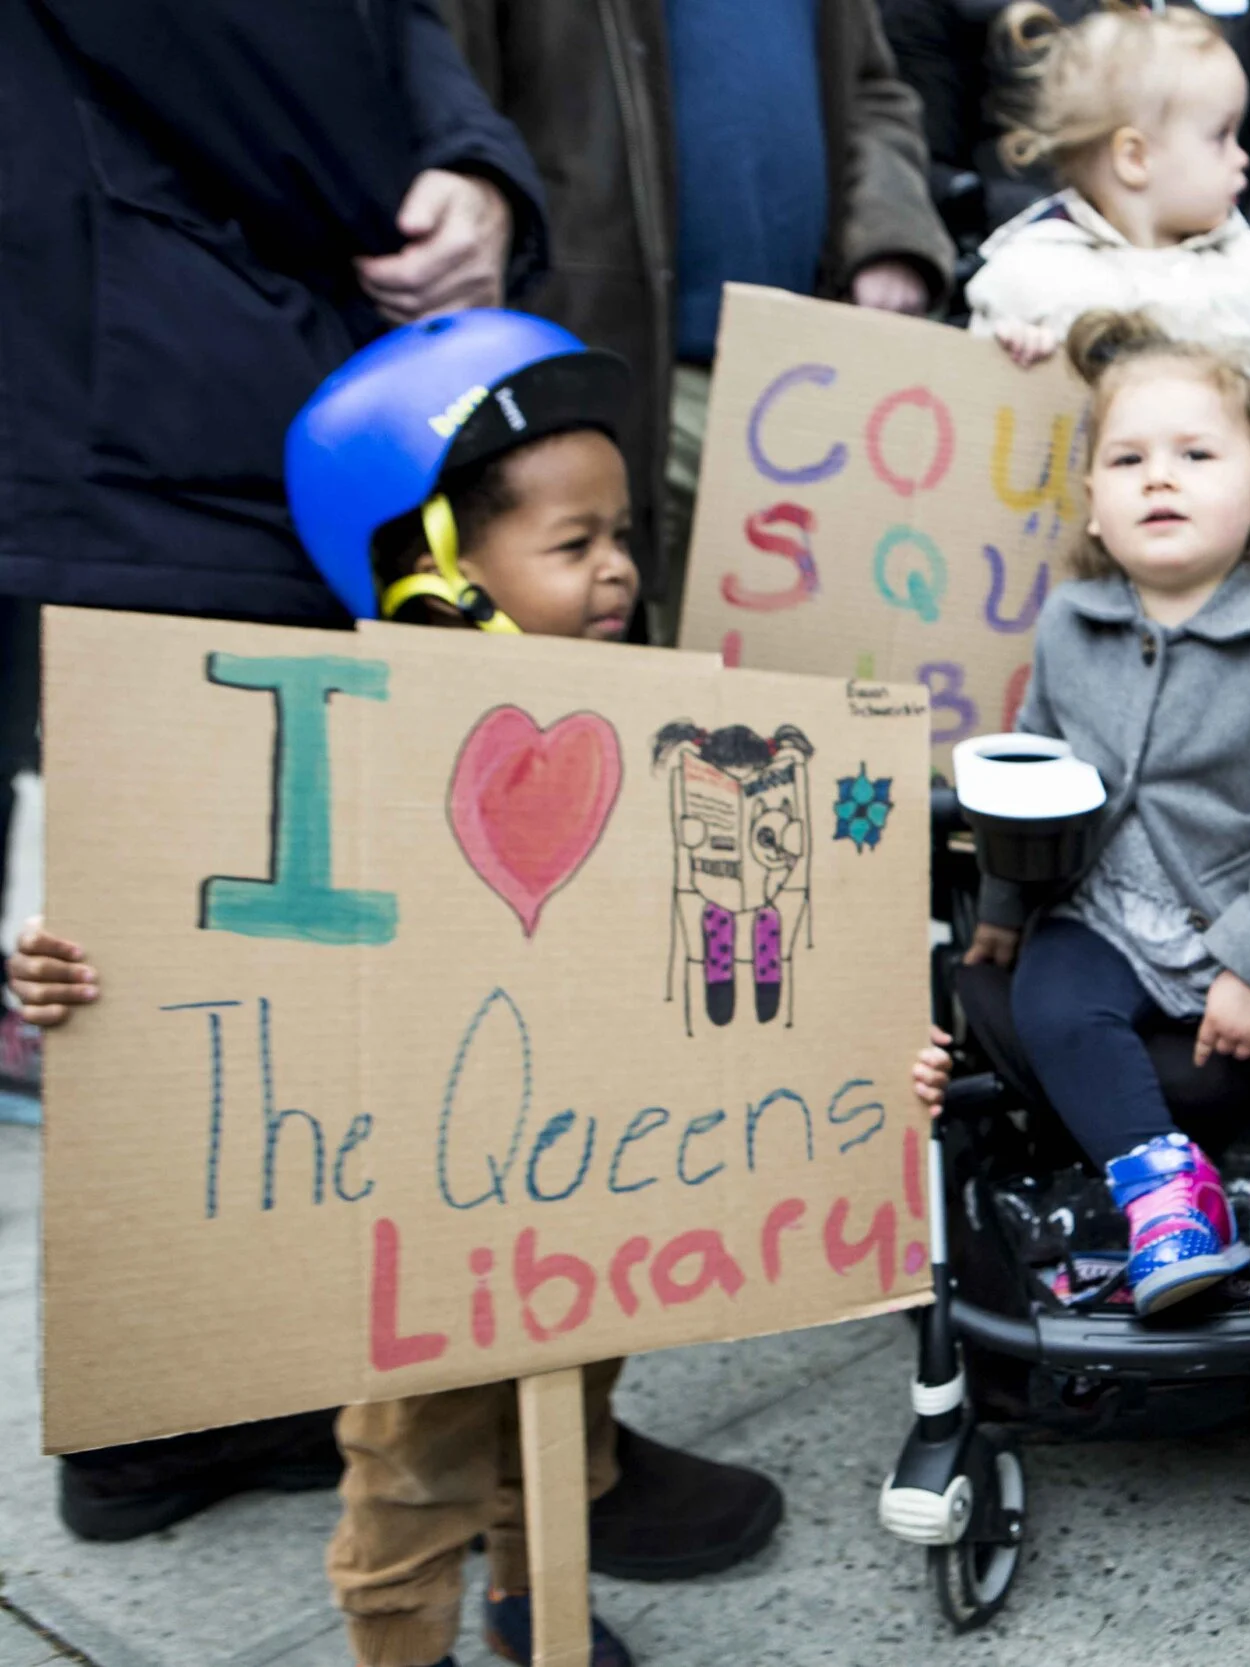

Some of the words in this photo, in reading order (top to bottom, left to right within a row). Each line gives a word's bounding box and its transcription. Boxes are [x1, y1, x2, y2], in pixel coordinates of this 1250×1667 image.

[720, 502, 1049, 634] SQU
[198, 652, 399, 945] I
[160, 996, 374, 1218] The
[436, 987, 886, 1210] Queens
[370, 1127, 927, 1372] Library!
